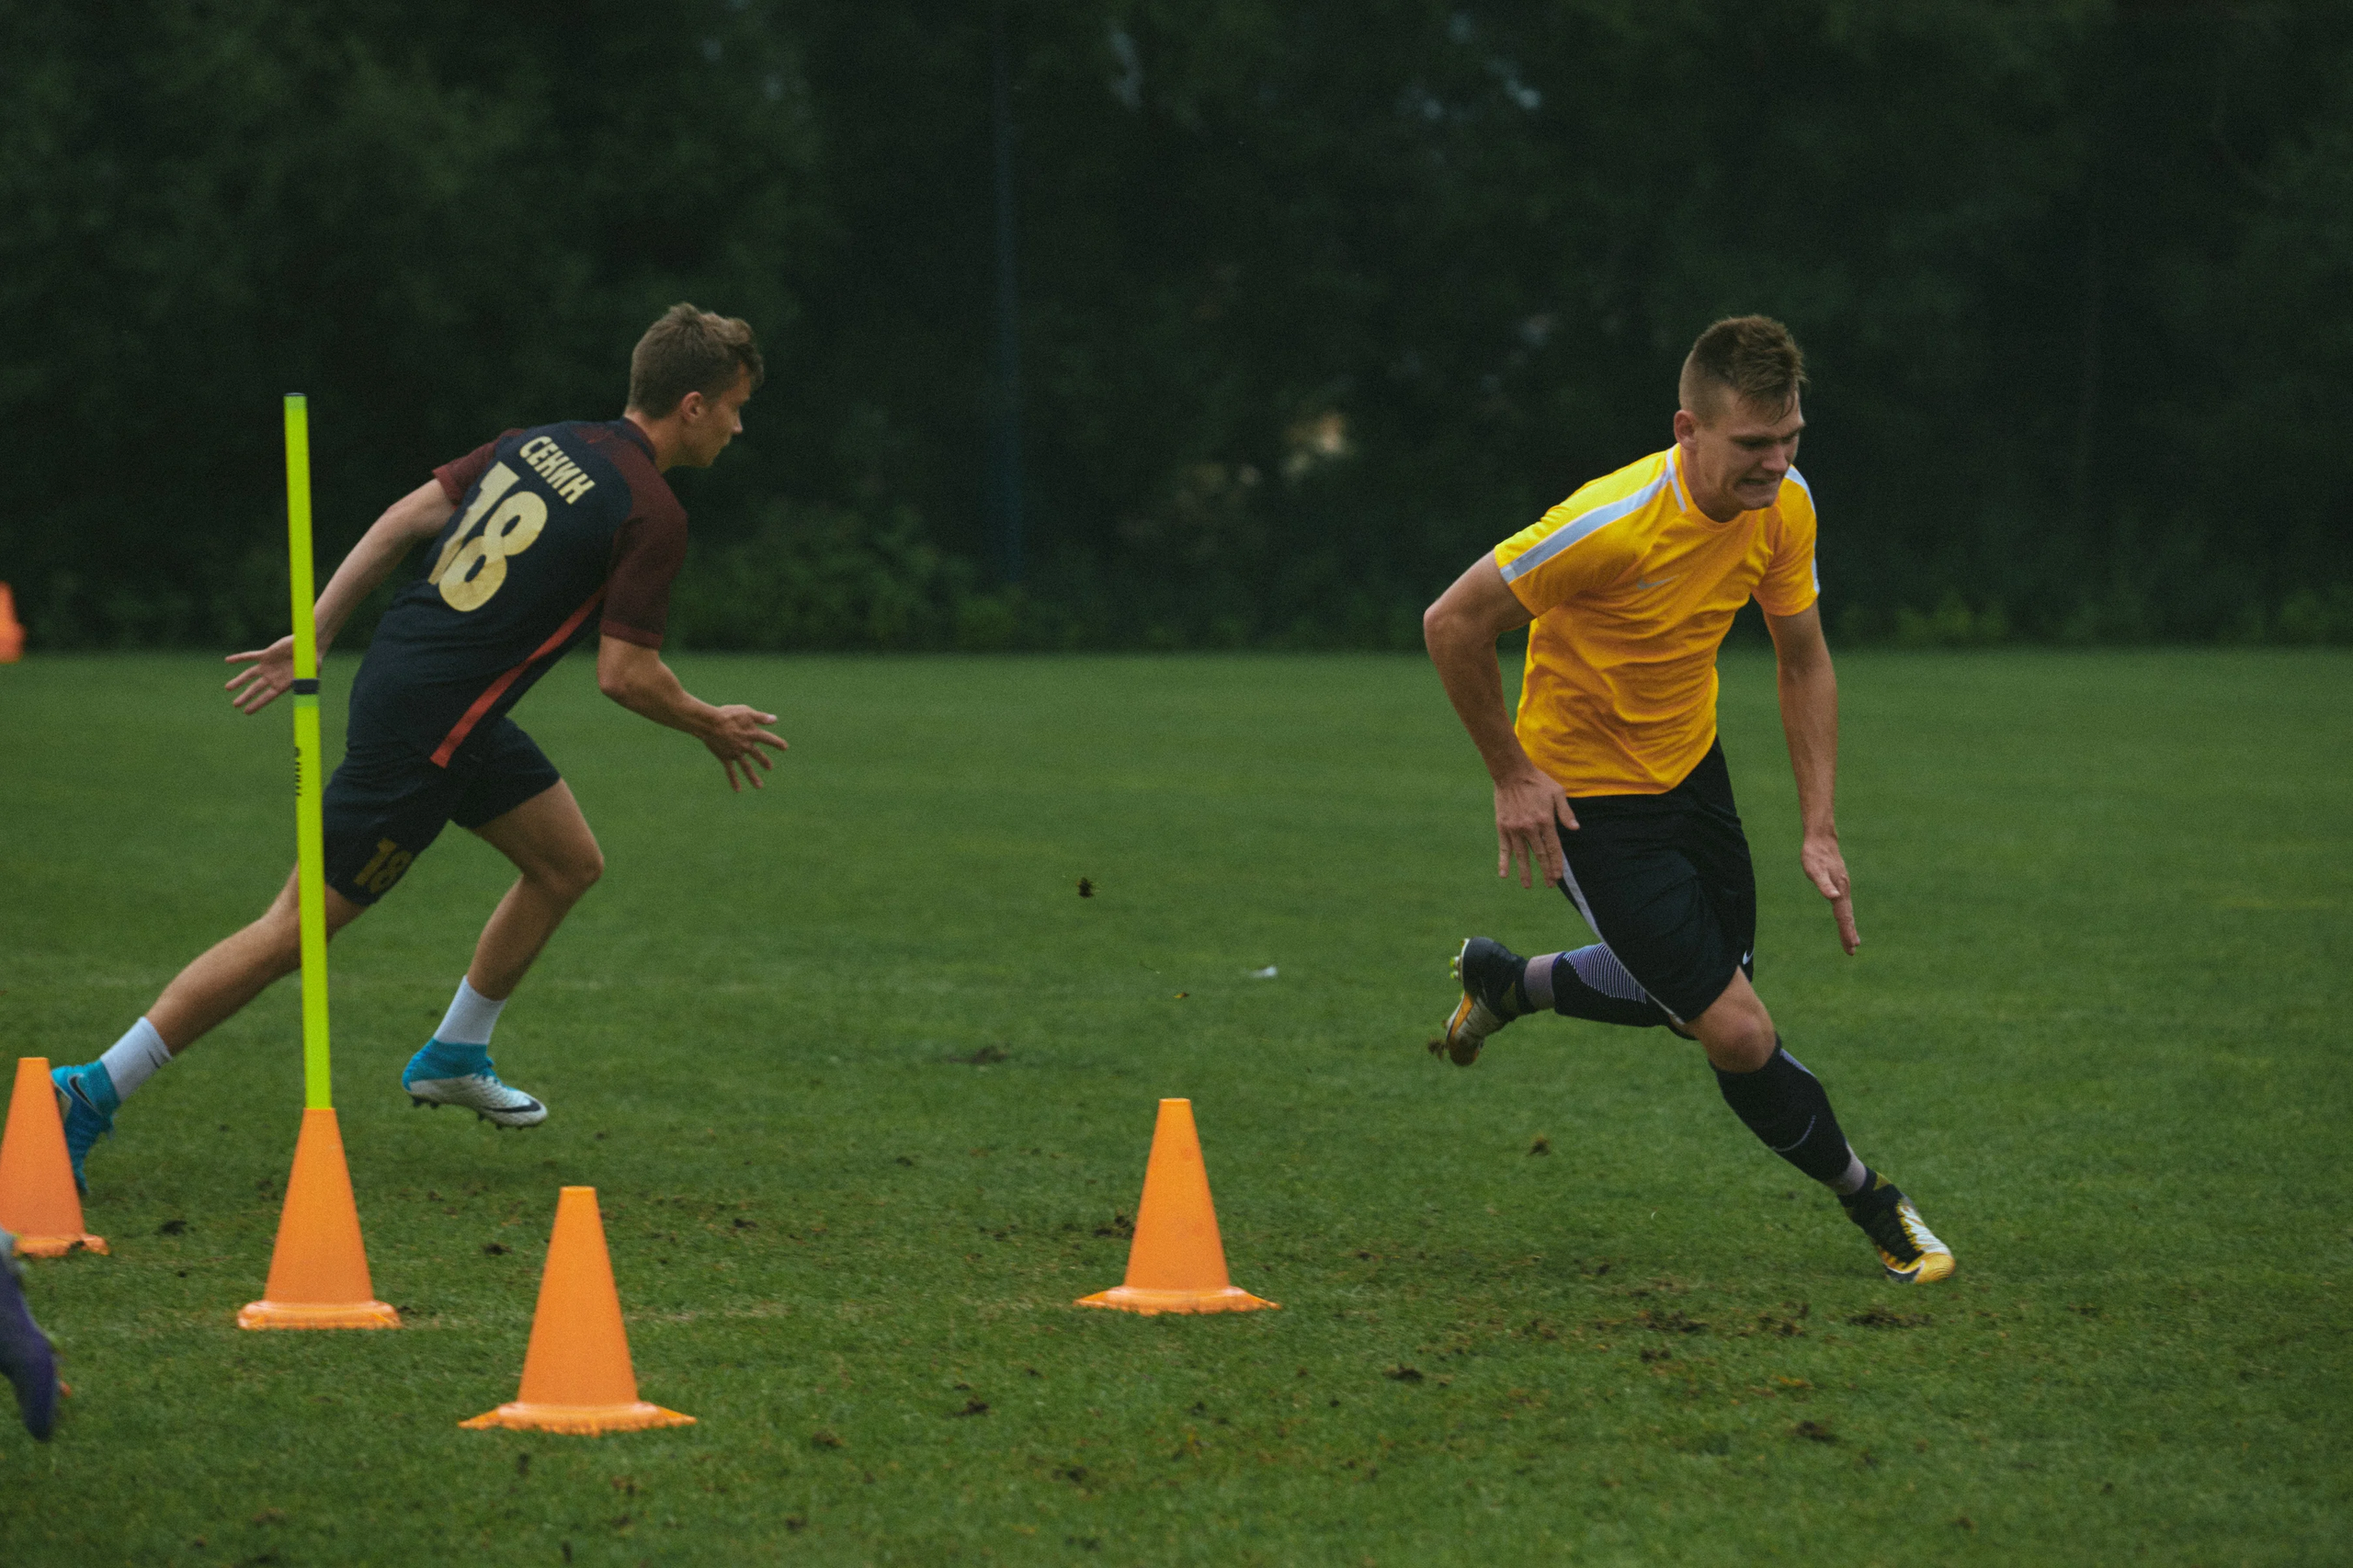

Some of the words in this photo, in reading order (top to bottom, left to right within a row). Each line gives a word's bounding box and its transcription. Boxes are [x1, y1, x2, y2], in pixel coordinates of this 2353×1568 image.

[519, 436, 596, 505] СЕНИН
[427, 461, 548, 612] 18
[353, 837, 413, 894] 18
